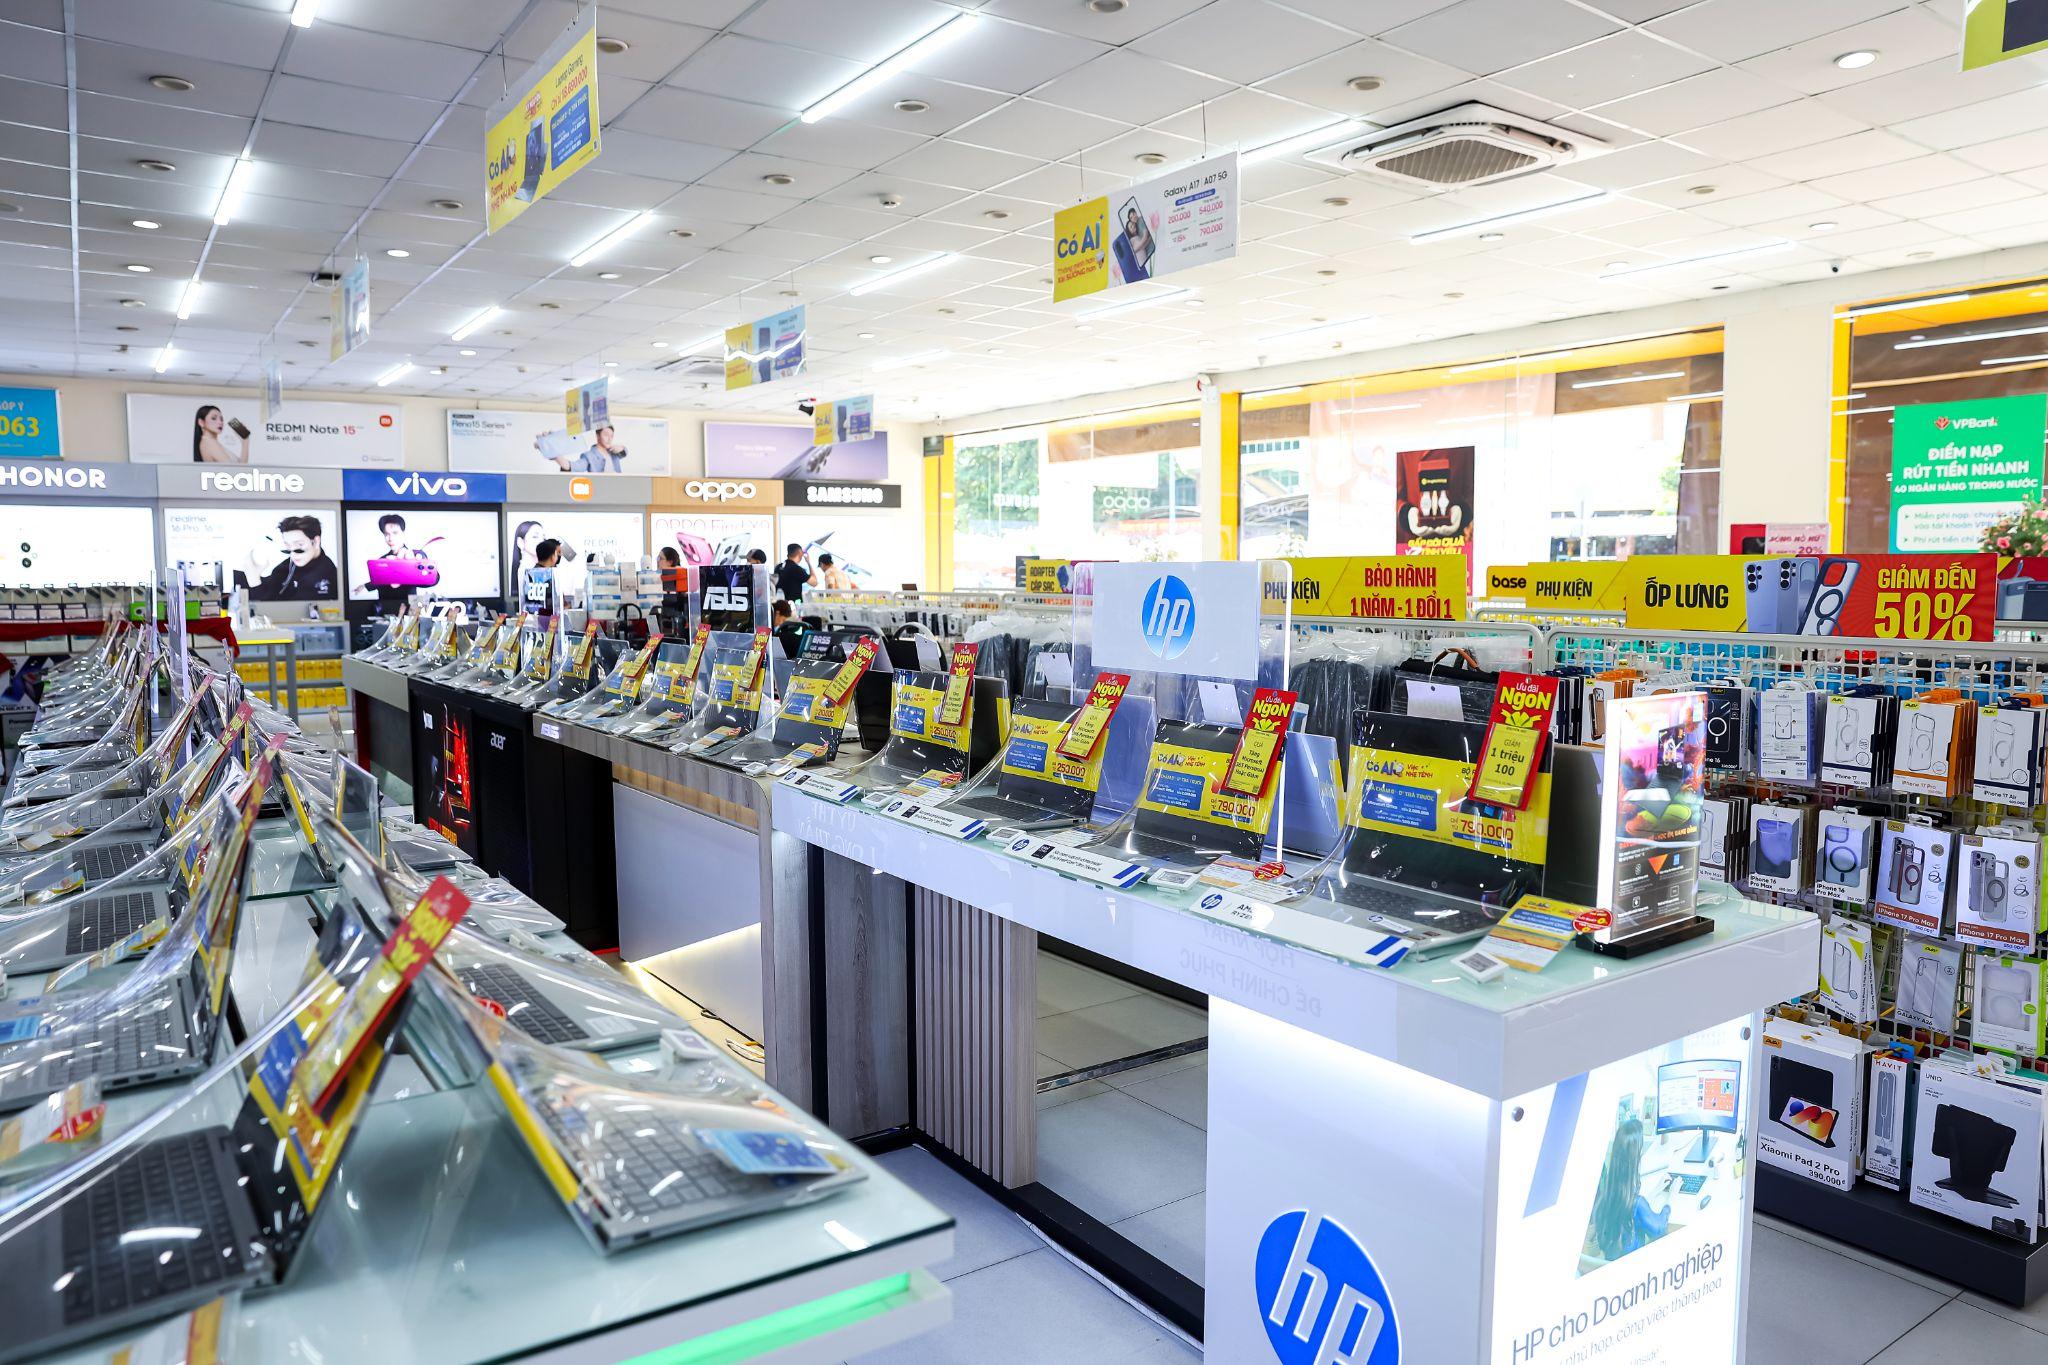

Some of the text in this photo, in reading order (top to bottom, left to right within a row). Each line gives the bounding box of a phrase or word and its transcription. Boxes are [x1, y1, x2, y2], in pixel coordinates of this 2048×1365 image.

[488, 157, 500, 181] Có
[1163, 181, 1188, 199] Galaxy
[1188, 179, 1200, 192] A17
[1203, 175, 1217, 187] A07
[1217, 170, 1228, 181] 5G
[1057, 221, 1101, 259] Có AI
[266, 423, 356, 435] REDMI Note 15
[1951, 416, 1999, 430] VPBank
[1969, 444, 2004, 461] NẠP
[0, 465, 107, 489] HONOR
[1903, 461, 2030, 480] RÚT TIỀN NHANH
[200, 468, 304, 493] realme
[386, 472, 468, 497] vivo
[1908, 481, 1937, 492] NGÂN
[1938, 479, 1967, 492] HÀNG
[1969, 480, 2005, 490] TRONG
[685, 481, 757, 503] oppo
[807, 486, 884, 504] SAMSUNG
[1030, 566, 1056, 577] ADAPTER
[1364, 563, 1437, 588] BẢO HÀNH
[1877, 562, 1977, 590] GIẢM ĐẾN
[527, 581, 550, 600] acer
[1264, 577, 1320, 604] PHỤ KIỆN
[1492, 575, 1527, 589] base
[1535, 578, 1593, 601] PHỤ KIỆN
[703, 586, 749, 611] ASUS
[1645, 576, 1729, 608] ỐP LƯNG
[1350, 598, 1359, 616] 1
[1360, 593, 1395, 617] NĂM
[1405, 598, 1412, 617] 1
[1416, 590, 1443, 618] ĐỔI
[1443, 598, 1453, 618] 1
[1143, 575, 1195, 660] hp
[1874, 592, 1975, 642] 50%
[855, 643, 875, 659] NgoN
[953, 652, 976, 666] NgoN
[1093, 681, 1125, 697] NgoN
[1516, 682, 1539, 693] Ưu đãi
[1500, 686, 1552, 711] NgoN
[1253, 699, 1291, 718] NgoN
[490, 731, 507, 751] acer
[1490, 747, 1525, 763] 1 triệu
[1366, 760, 1380, 772] Có
[1495, 763, 1515, 776] 100
[1984, 790, 2002, 798] iPhone
[1460, 819, 1514, 841] 790.000
[1750, 875, 1769, 883] iPhone
[1816, 884, 1838, 892] iPhone
[1200, 893, 1223, 910] hp
[1878, 907, 1900, 918] iPhone
[1908, 915, 1920, 923] Pro
[1921, 919, 1935, 927] Max
[1960, 927, 1985, 937] iPhone
[2010, 936, 2026, 944] Max
[1897, 1010, 1933, 1026] GALAXY A26
[1873, 1061, 1903, 1071] HAVIT
[1925, 1073, 1943, 1082] UNIQ
[1760, 1141, 1840, 1176] Xiaomi Pad 2 Pro
[1931, 1190, 1943, 1198] 360
[1255, 1209, 1402, 1365] hp
[1511, 1242, 1723, 1365] HP cho Doanh nghiệp
[1616, 1321, 1645, 1342] công
[1646, 1308, 1669, 1327] việc
[1671, 1291, 1701, 1314] thăng
[1702, 1276, 1722, 1296] hoa
